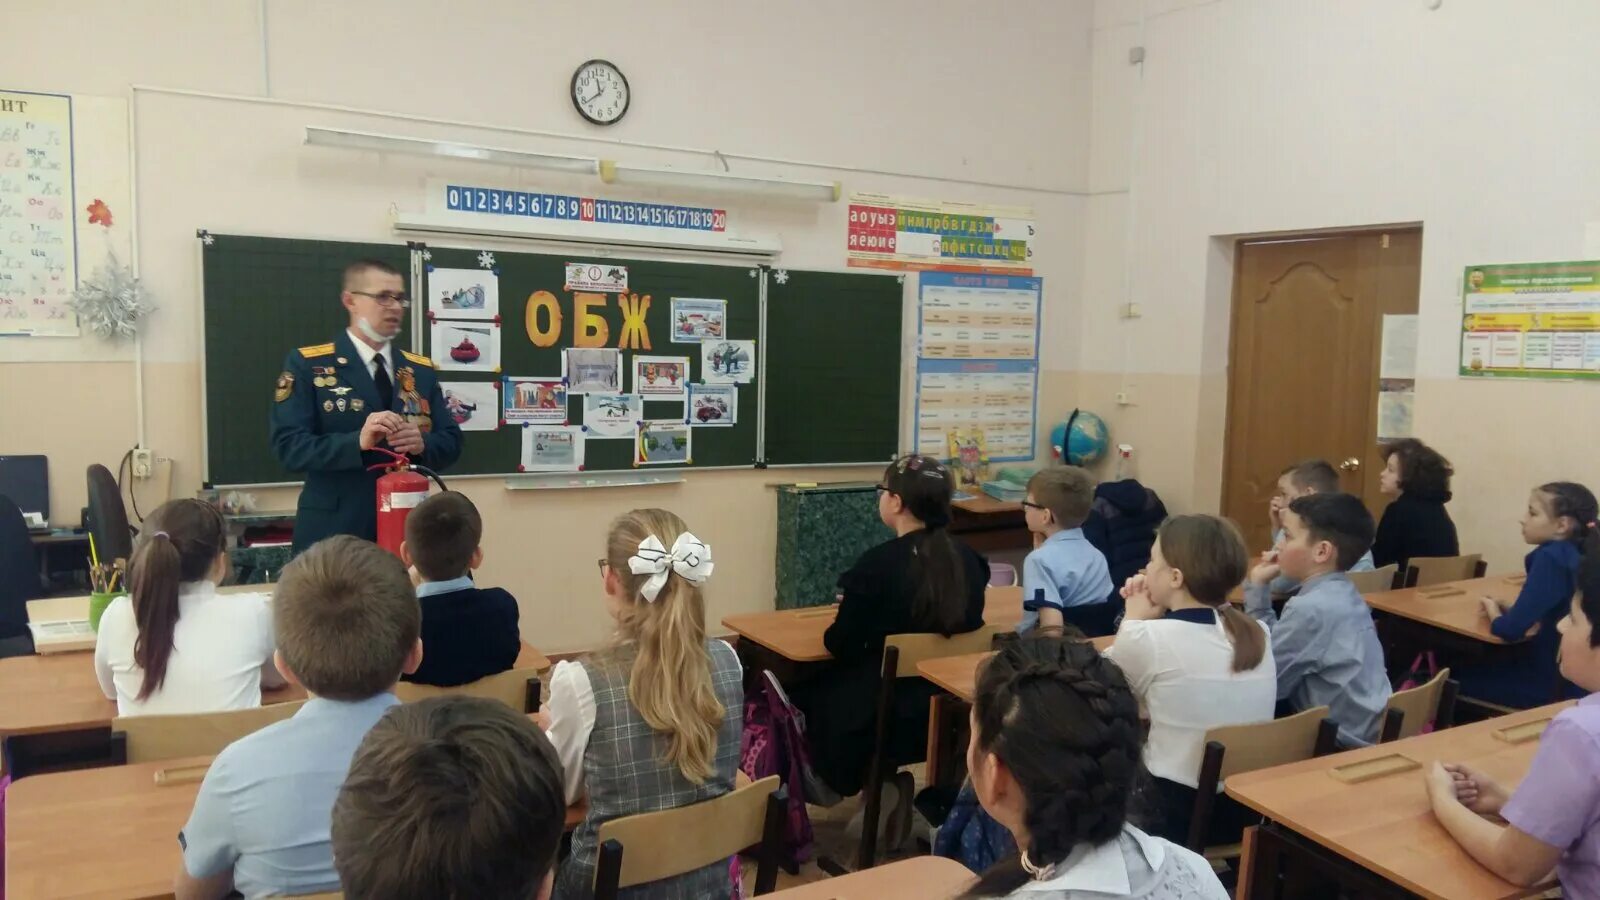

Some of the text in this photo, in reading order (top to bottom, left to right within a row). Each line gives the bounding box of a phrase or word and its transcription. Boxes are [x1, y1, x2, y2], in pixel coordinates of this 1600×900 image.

[587, 70, 596, 79] 11
[595, 68, 605, 78] 12
[607, 72, 612, 81] 1
[580, 77, 590, 87] 10
[612, 81, 618, 90] 2
[577, 86, 583, 96] 9
[616, 90, 622, 100] 3
[580, 95, 587, 105] 8
[588, 104, 593, 114] 7
[597, 108, 603, 118] 6
[606, 107, 613, 116] 5
[449, 189, 726, 229] 0 1 2 3 4 5 6 7 8 9 10 11 12 13 14 15 16 17 18 19 20
[850, 210, 857, 222] а
[860, 211, 868, 222] о
[870, 212, 877, 228] у
[878, 212, 888, 224] ы
[888, 214, 896, 225] э
[942, 215, 949, 231] б
